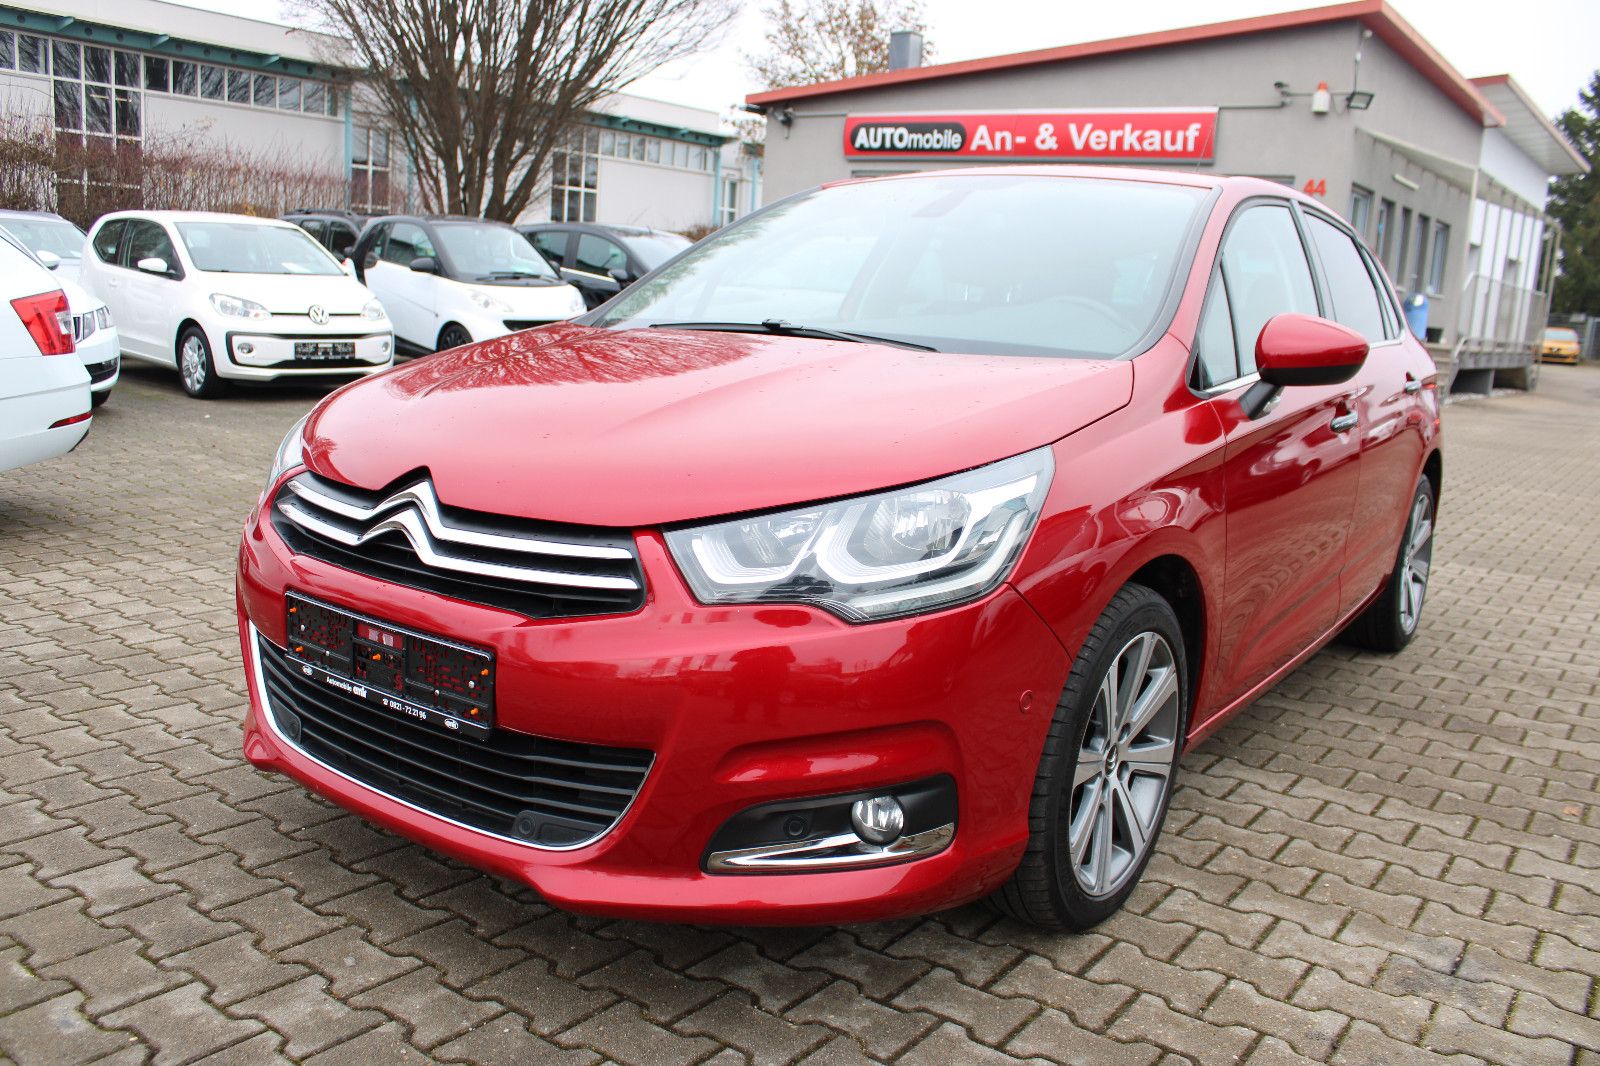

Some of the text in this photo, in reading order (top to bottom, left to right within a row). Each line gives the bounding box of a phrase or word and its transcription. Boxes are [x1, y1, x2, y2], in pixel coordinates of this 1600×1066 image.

[854, 122, 1201, 152] AUTOmobile An- & Verkauf
[1303, 178, 1326, 197] 44
